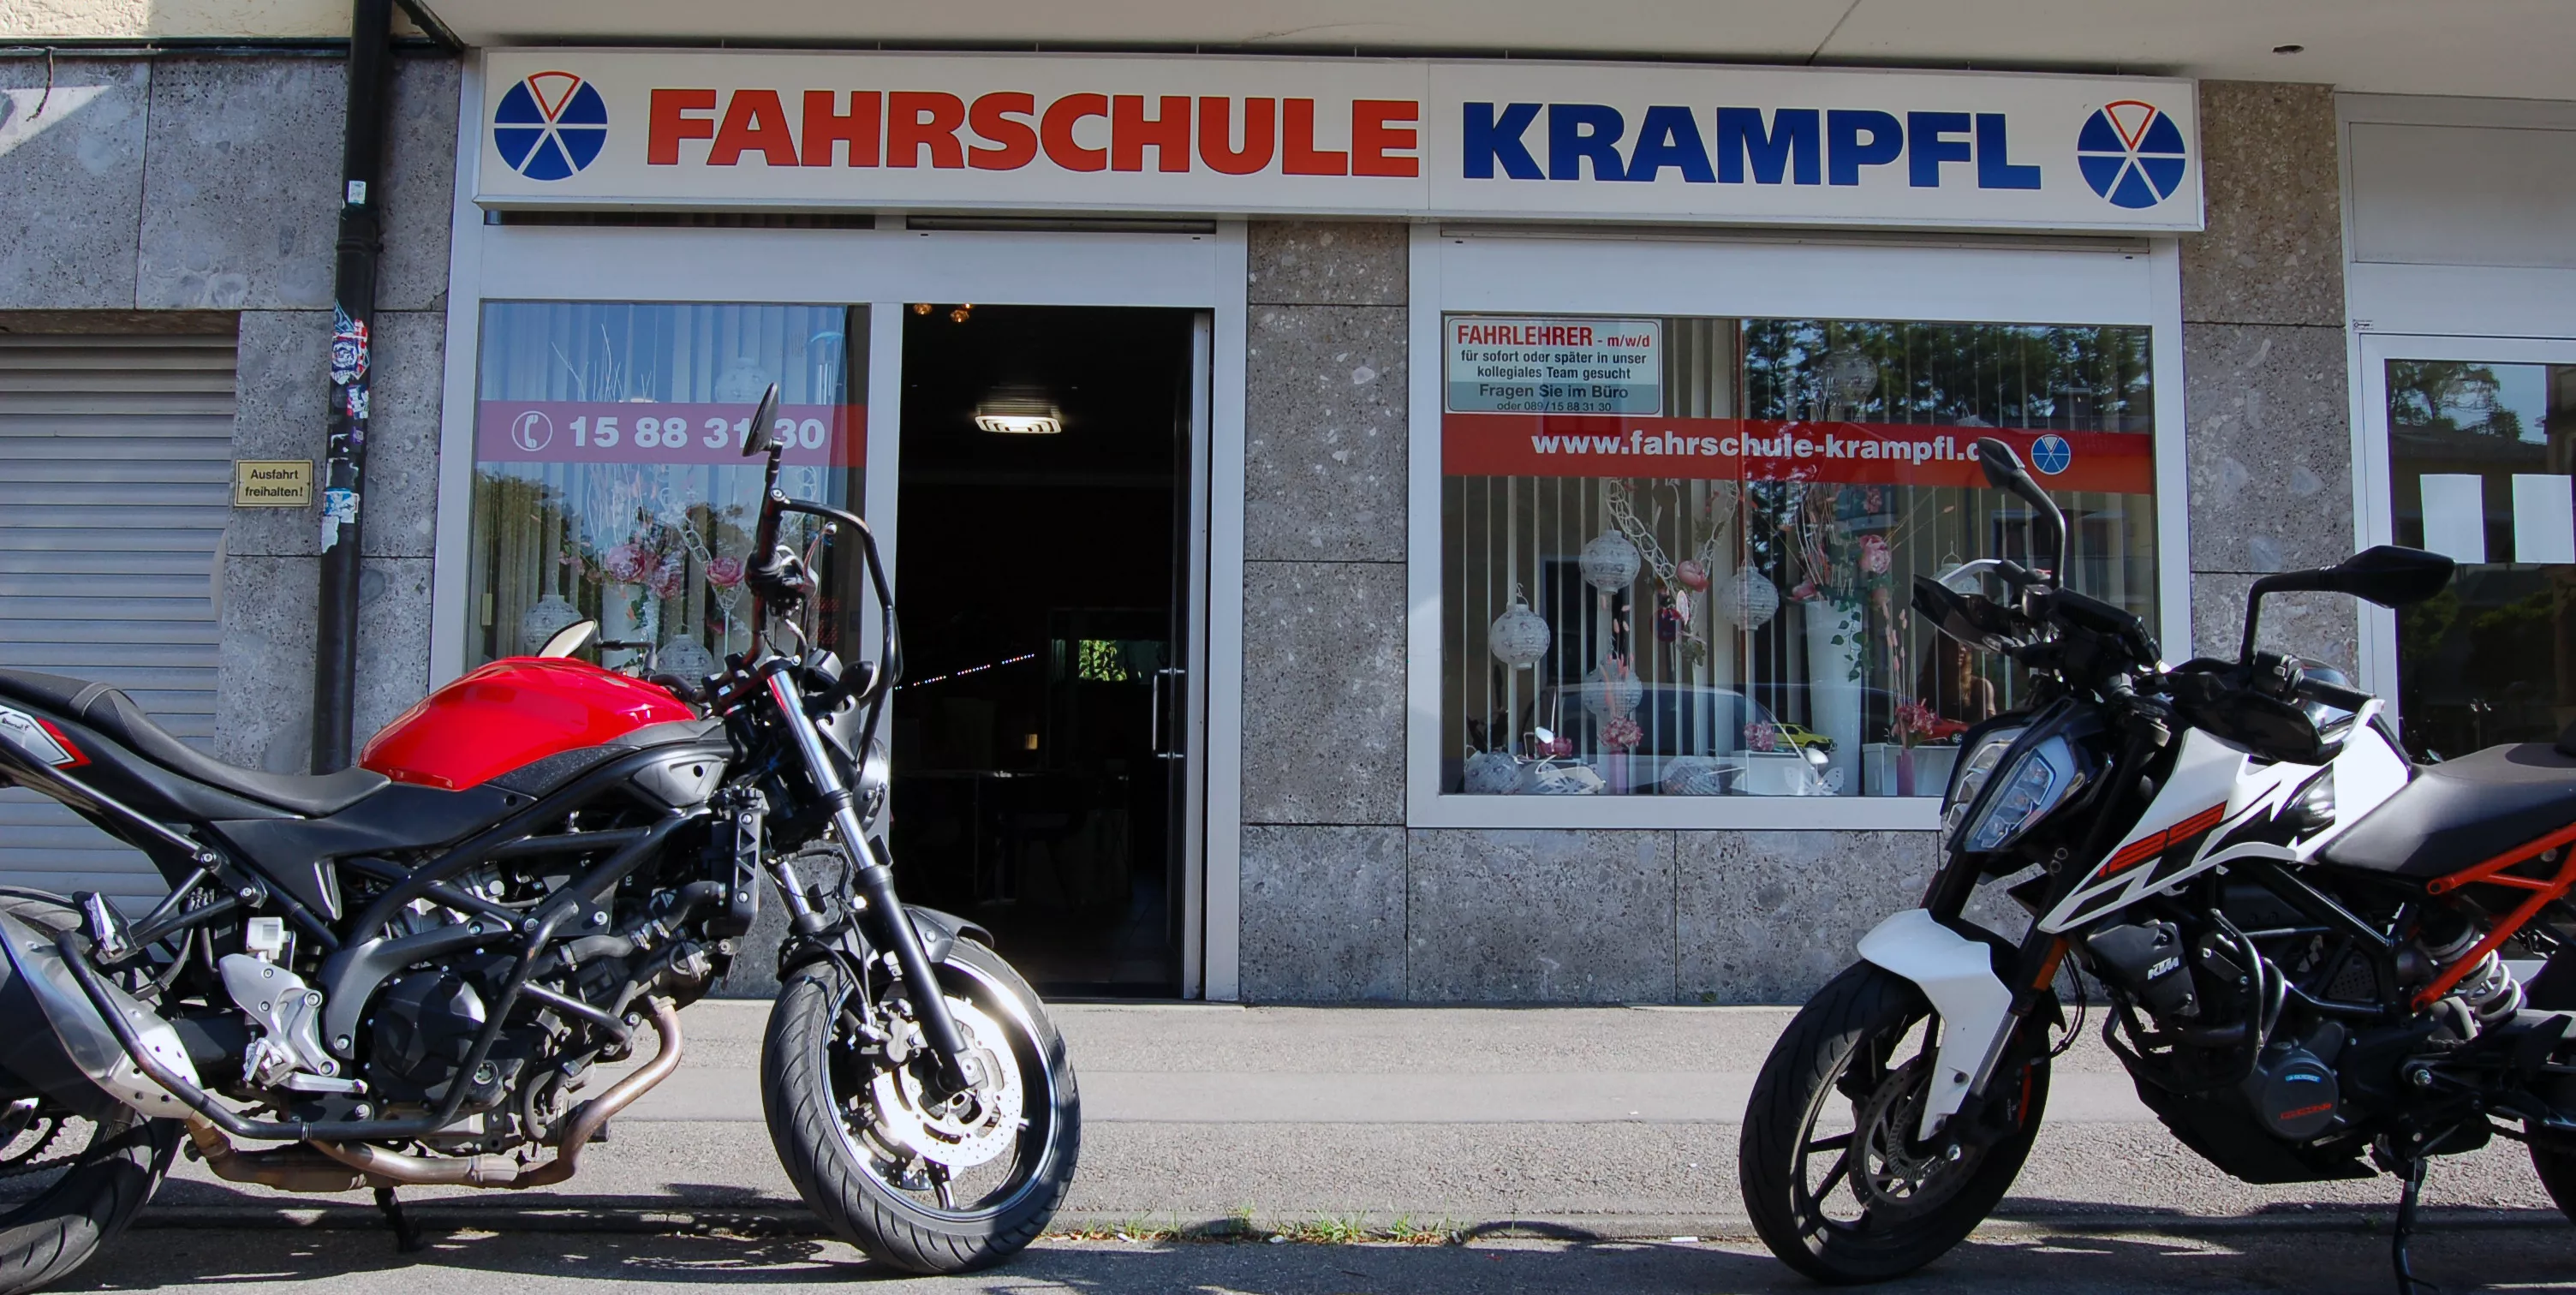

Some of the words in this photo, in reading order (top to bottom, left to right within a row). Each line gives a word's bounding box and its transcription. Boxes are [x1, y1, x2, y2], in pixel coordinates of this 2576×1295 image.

[647, 88, 1419, 176] FAHRSCHULE
[1463, 101, 2042, 189] KRAMPFL
[1458, 325, 1594, 347] FAHRLEHRER
[1607, 334, 1651, 348] m/w/d
[1461, 349, 1479, 361] für
[1482, 349, 1519, 362] sofort
[1523, 350, 1549, 363] oder
[1554, 351, 1594, 366] später
[1597, 352, 1608, 363] in
[1613, 353, 1647, 364] unser
[1477, 365, 1542, 379] kollegiales
[1546, 367, 1578, 379] Team
[1583, 367, 1631, 380] gesucht
[1479, 383, 1534, 399] Fragen
[1539, 384, 1563, 398] Sie
[1567, 385, 1587, 398] im
[1591, 385, 1629, 398] Büro
[1496, 402, 1522, 411] oder
[1566, 402, 1581, 412] 88
[1583, 403, 1595, 412] 31
[1598, 403, 1612, 412] 30
[569, 416, 620, 448] 15
[635, 417, 688, 449] 88
[702, 417, 750, 449] 31
[774, 418, 826, 450] 30
[250, 468, 299, 480] Ausfahrt
[245, 486, 303, 497] freihalten!
[2098, 800, 2227, 877] 125
[2147, 956, 2179, 981] KTM
